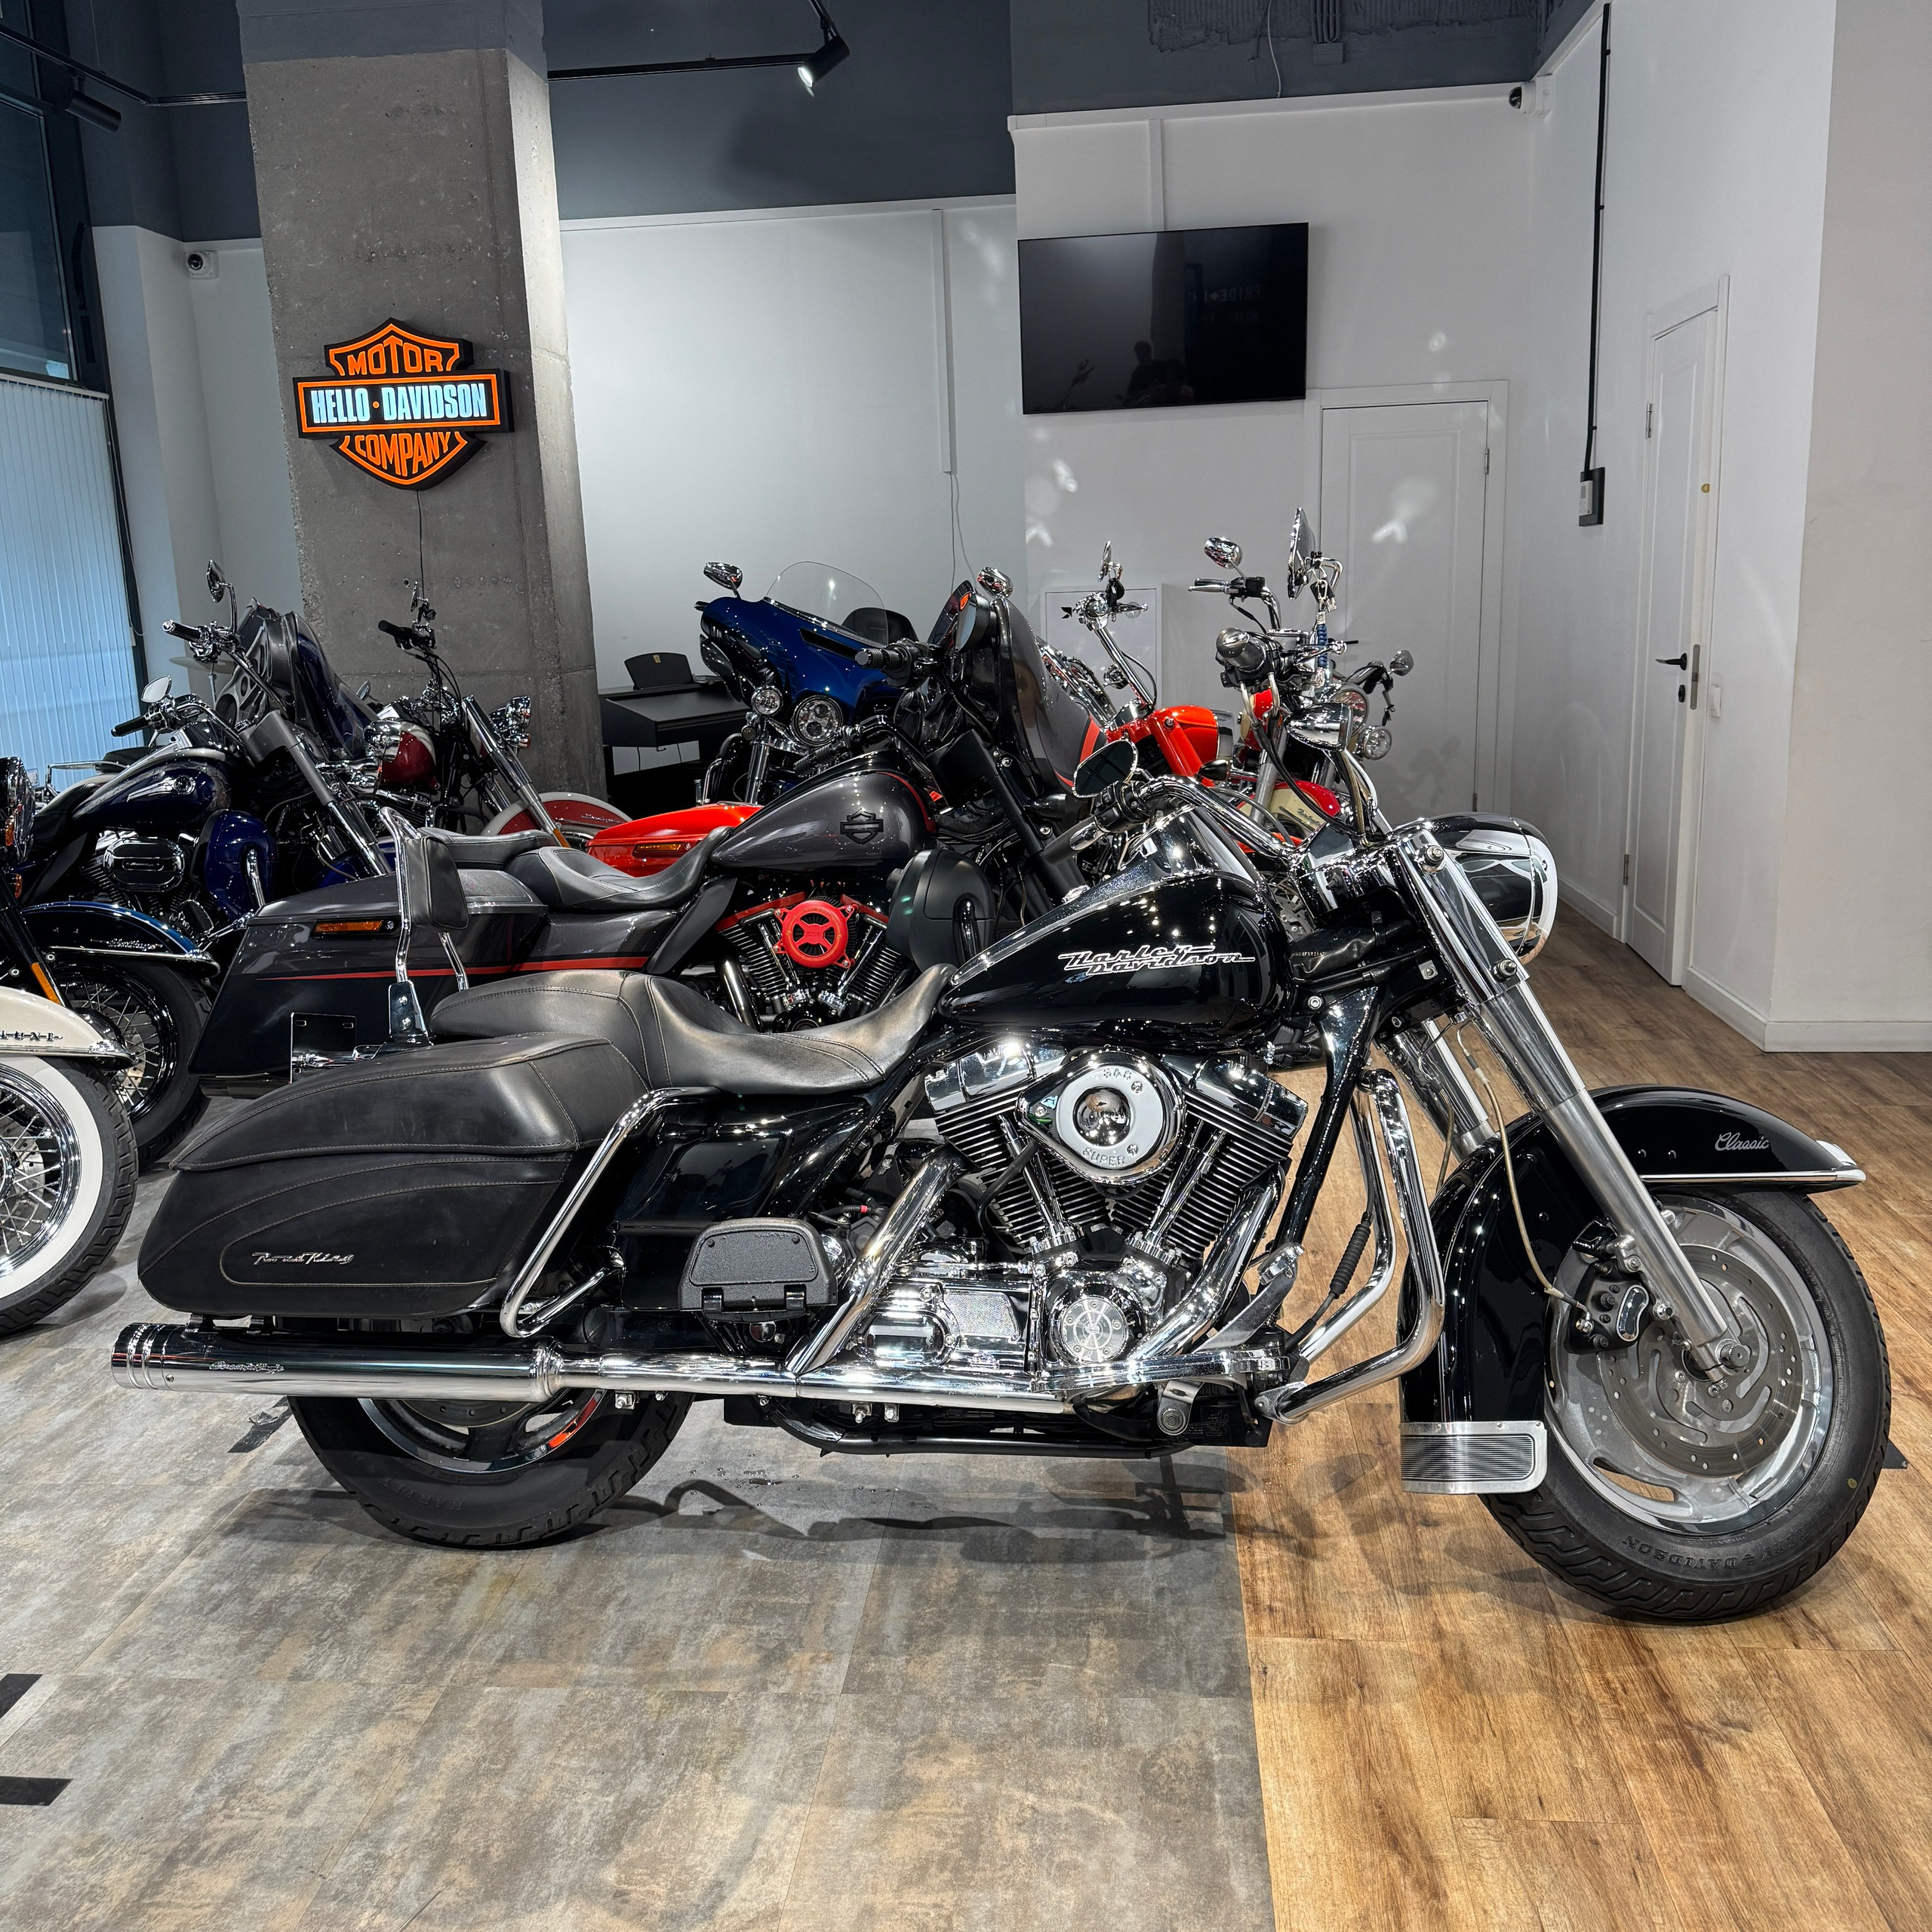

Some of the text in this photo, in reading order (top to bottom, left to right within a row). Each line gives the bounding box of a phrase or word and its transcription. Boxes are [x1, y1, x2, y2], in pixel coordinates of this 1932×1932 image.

[347, 335, 443, 375] MOTOR
[310, 383, 488, 423] HELLO DAVIDSON
[355, 432, 451, 476] COMPANY
[1058, 945, 1216, 971] Harley
[1085, 953, 1255, 975] Davidson
[1082, 1147, 1126, 1166] SUPER
[1715, 1132, 1770, 1151] Classic
[1622, 1534, 1739, 1571] DAVIDSON
